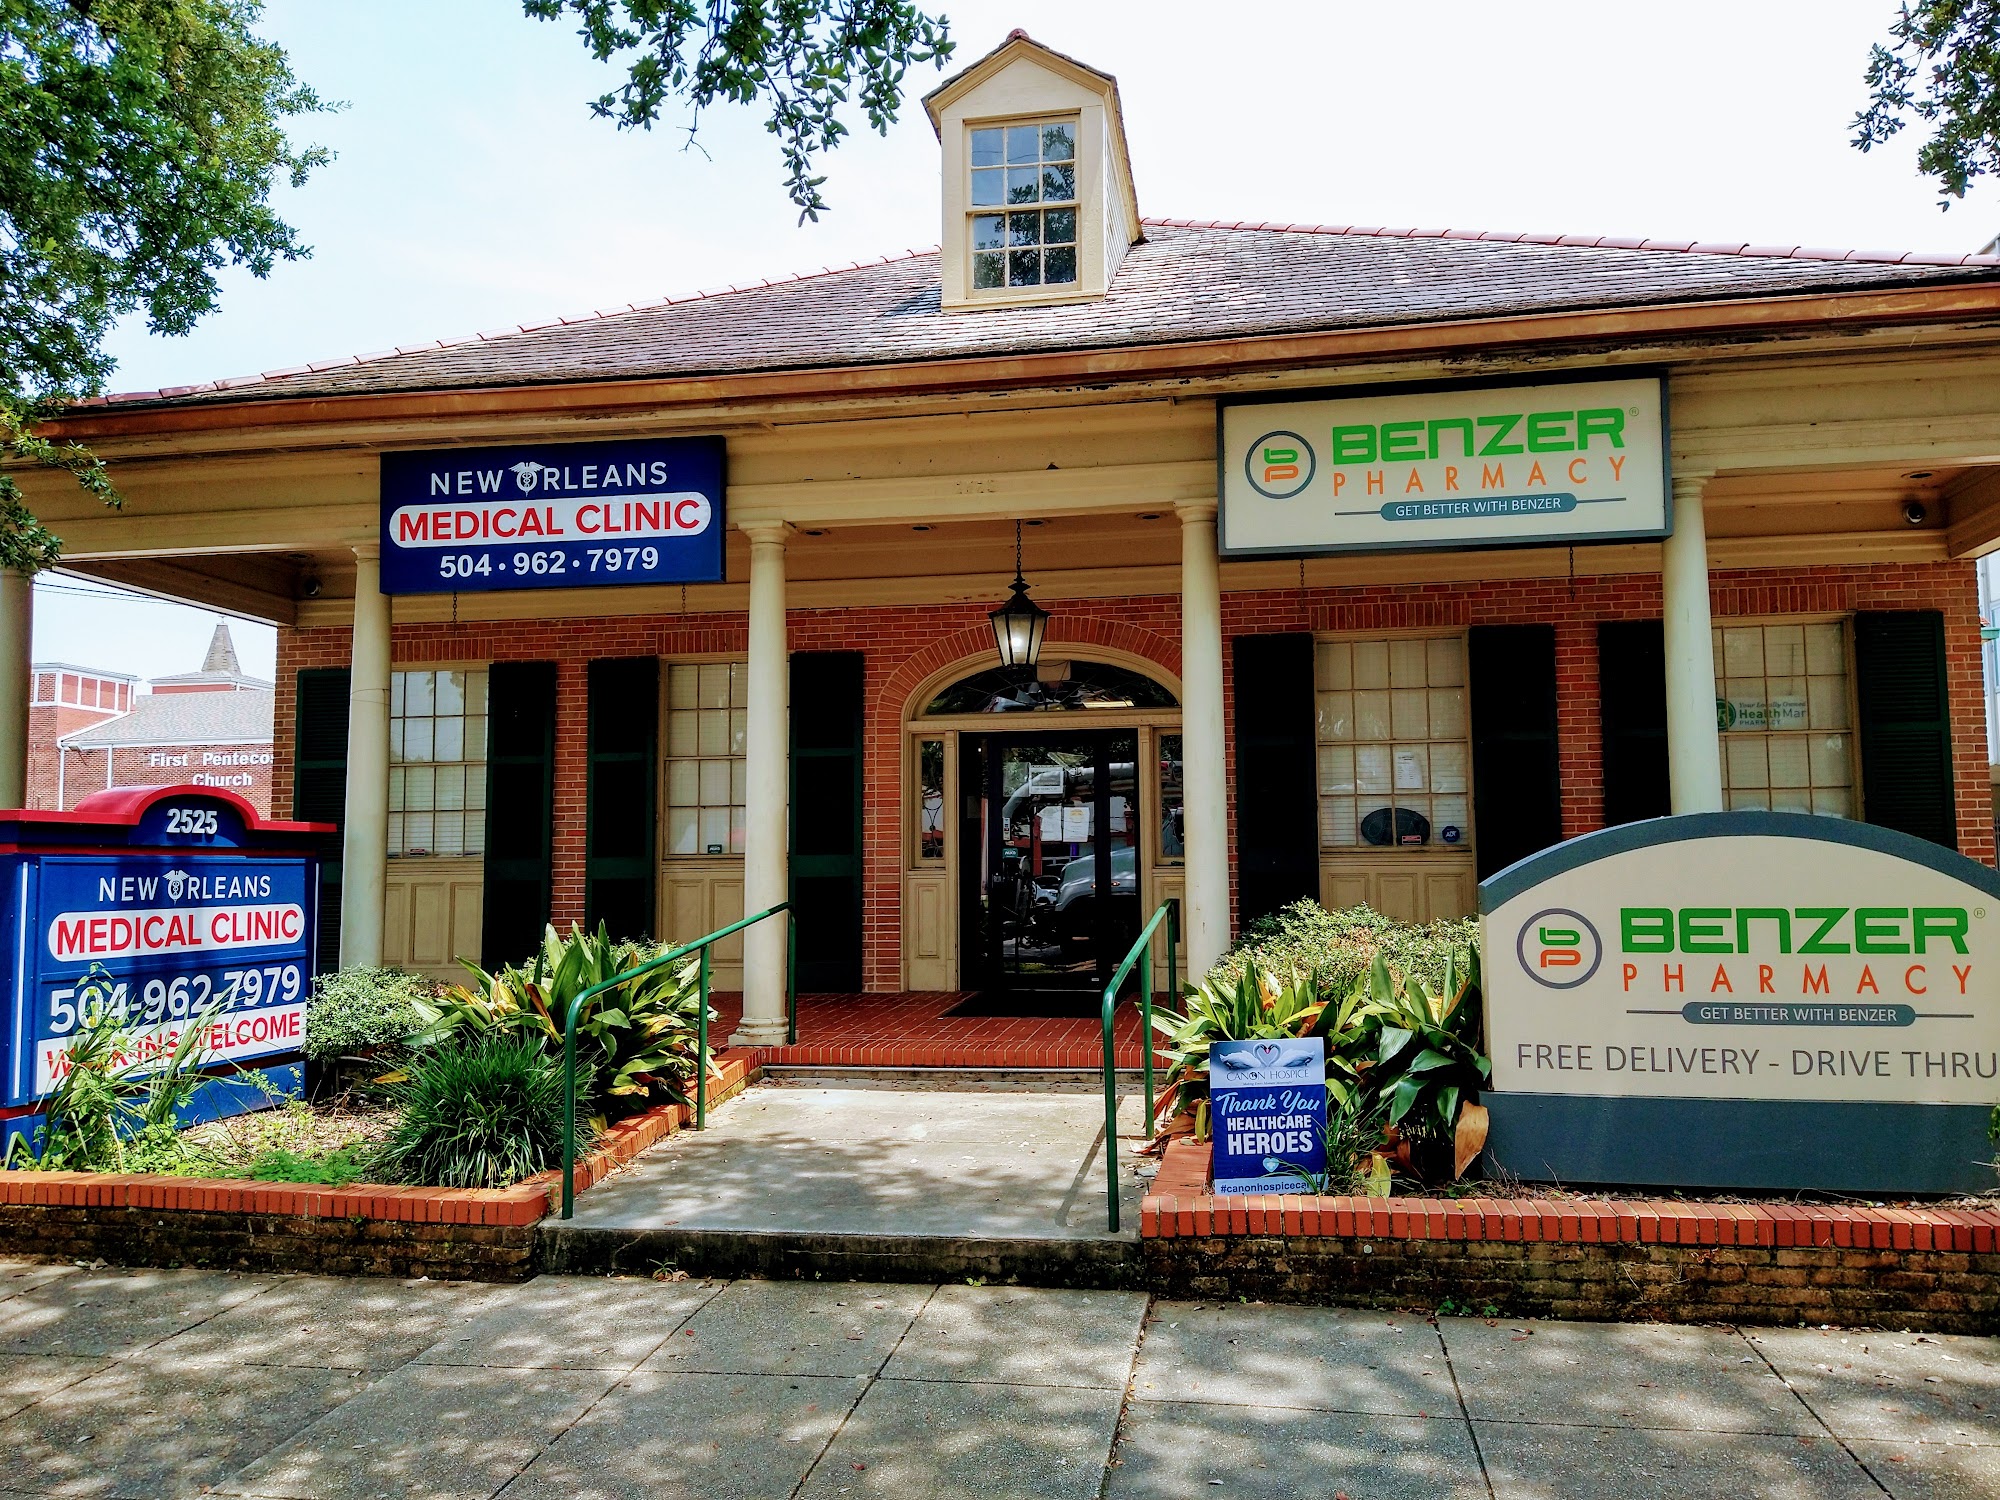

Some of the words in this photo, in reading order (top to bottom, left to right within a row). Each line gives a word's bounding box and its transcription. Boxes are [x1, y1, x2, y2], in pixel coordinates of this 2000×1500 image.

[1332, 408, 1626, 466] BENZER
[431, 469, 504, 496] NEW
[514, 461, 668, 495] ORLEANS
[1333, 456, 1627, 497] PHARMACY
[399, 506, 564, 542] MEDICAL
[575, 499, 701, 534] CLINIC
[1395, 504, 1420, 518] GET
[1423, 502, 1470, 516] BETTER
[1472, 500, 1509, 514] WITH
[1511, 497, 1561, 512] BENZER
[150, 752, 188, 767] First
[192, 772, 253, 786] Church
[166, 808, 218, 835] 2525
[99, 876, 158, 902] NEW
[165, 870, 271, 902] ORLEANS
[56, 914, 202, 955] MEDICAL
[211, 909, 299, 943] CLINIC
[1619, 907, 1971, 955] BENZER
[1623, 963, 1972, 995] PHARMACY
[1700, 1006, 1732, 1021] GET
[1734, 1007, 1789, 1022] BETTER
[1792, 1008, 1835, 1022] WITH
[1838, 1008, 1897, 1023] BENZER
[1226, 1071, 1266, 1082] CANON
[1270, 1068, 1309, 1079] HOSPICE
[1517, 1043, 1592, 1071] FREE
[1605, 1046, 1760, 1075] DELIVERY
[1792, 1050, 1890, 1078] DRIVE
[1902, 1051, 1997, 1079] THRU
[1216, 1092, 1276, 1116] Thank
[1280, 1090, 1320, 1116] You
[1227, 1115, 1312, 1131] HEALTHCARE
[1228, 1131, 1313, 1155] HEROES
